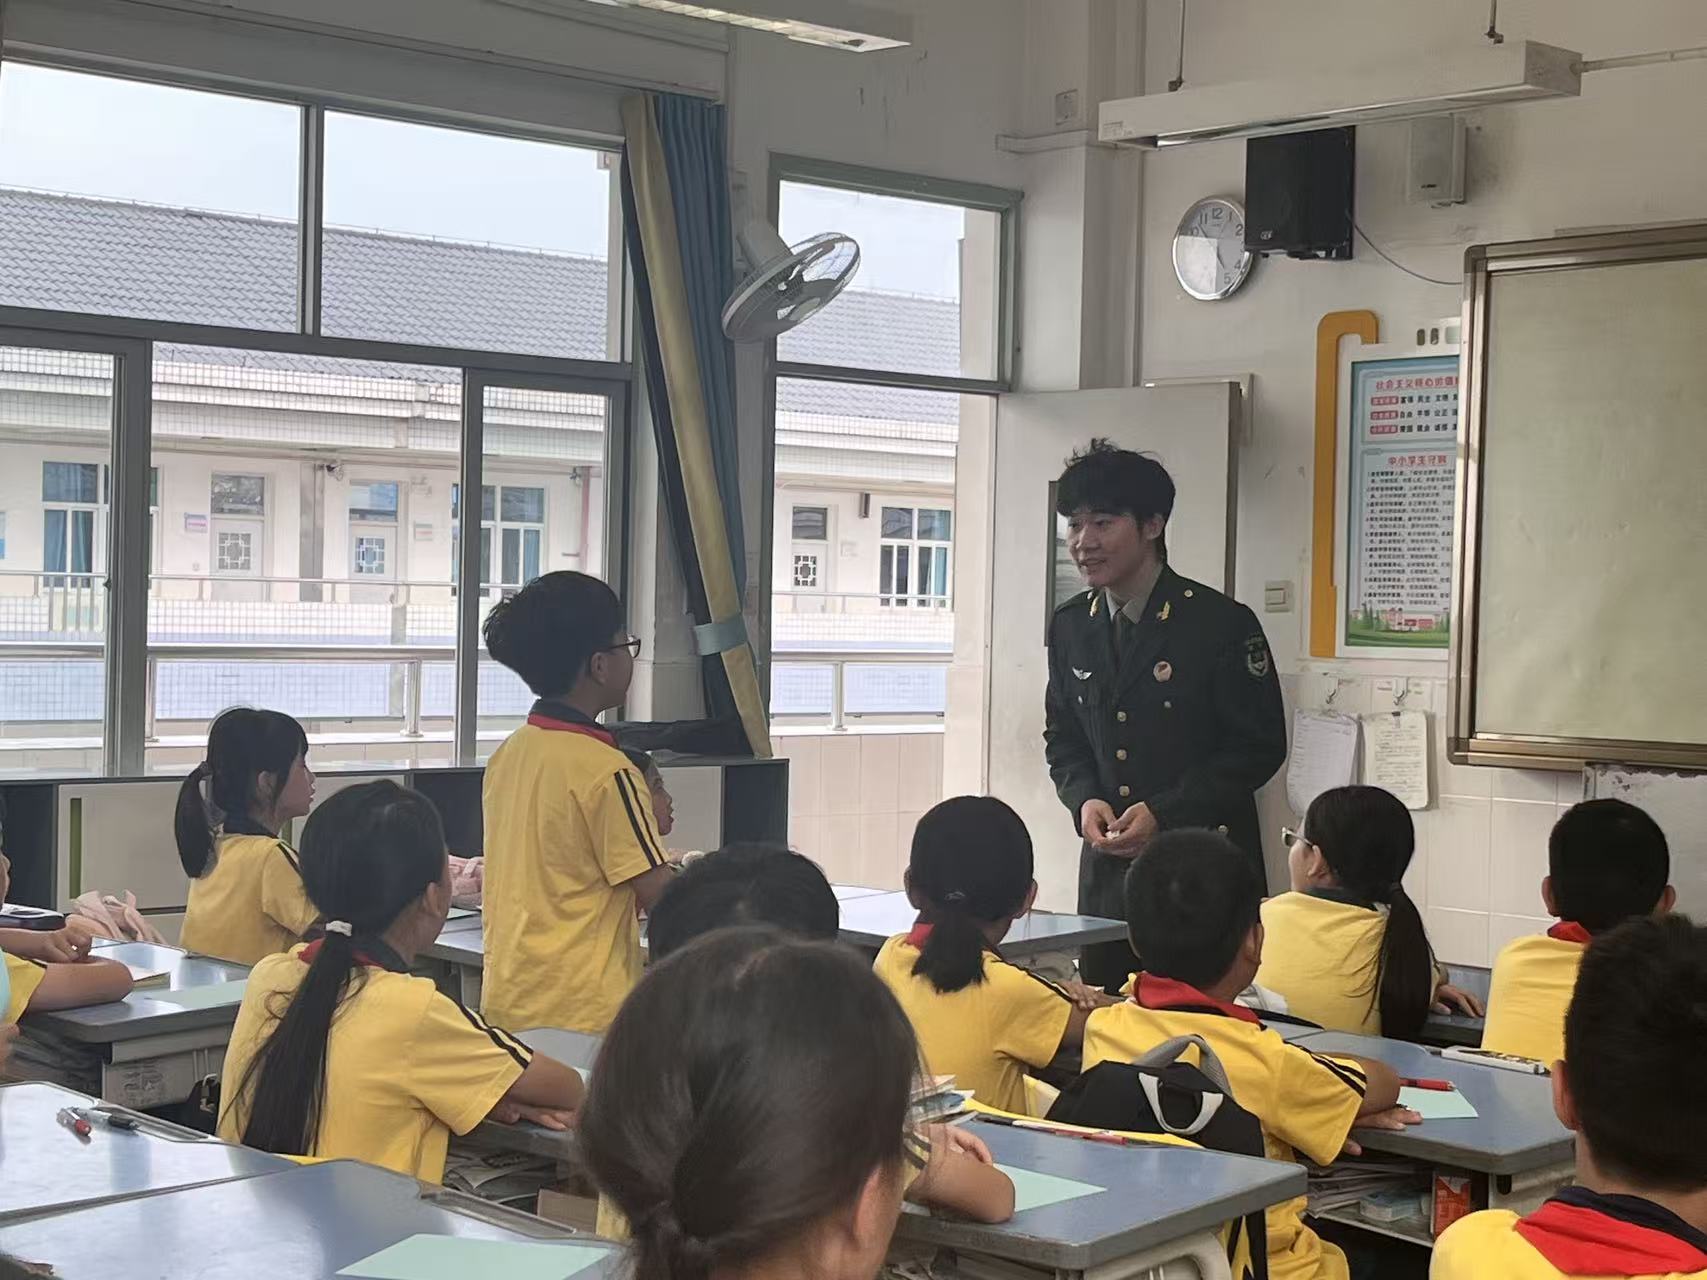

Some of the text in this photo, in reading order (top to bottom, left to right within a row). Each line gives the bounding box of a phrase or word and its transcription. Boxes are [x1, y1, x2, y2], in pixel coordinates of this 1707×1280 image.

[1200, 212, 1208, 224] 11
[1212, 208, 1223, 219] 12
[1235, 223, 1243, 236] 2
[1223, 272, 1231, 285] 5
[1388, 455, 1447, 465] 中小学生守则
